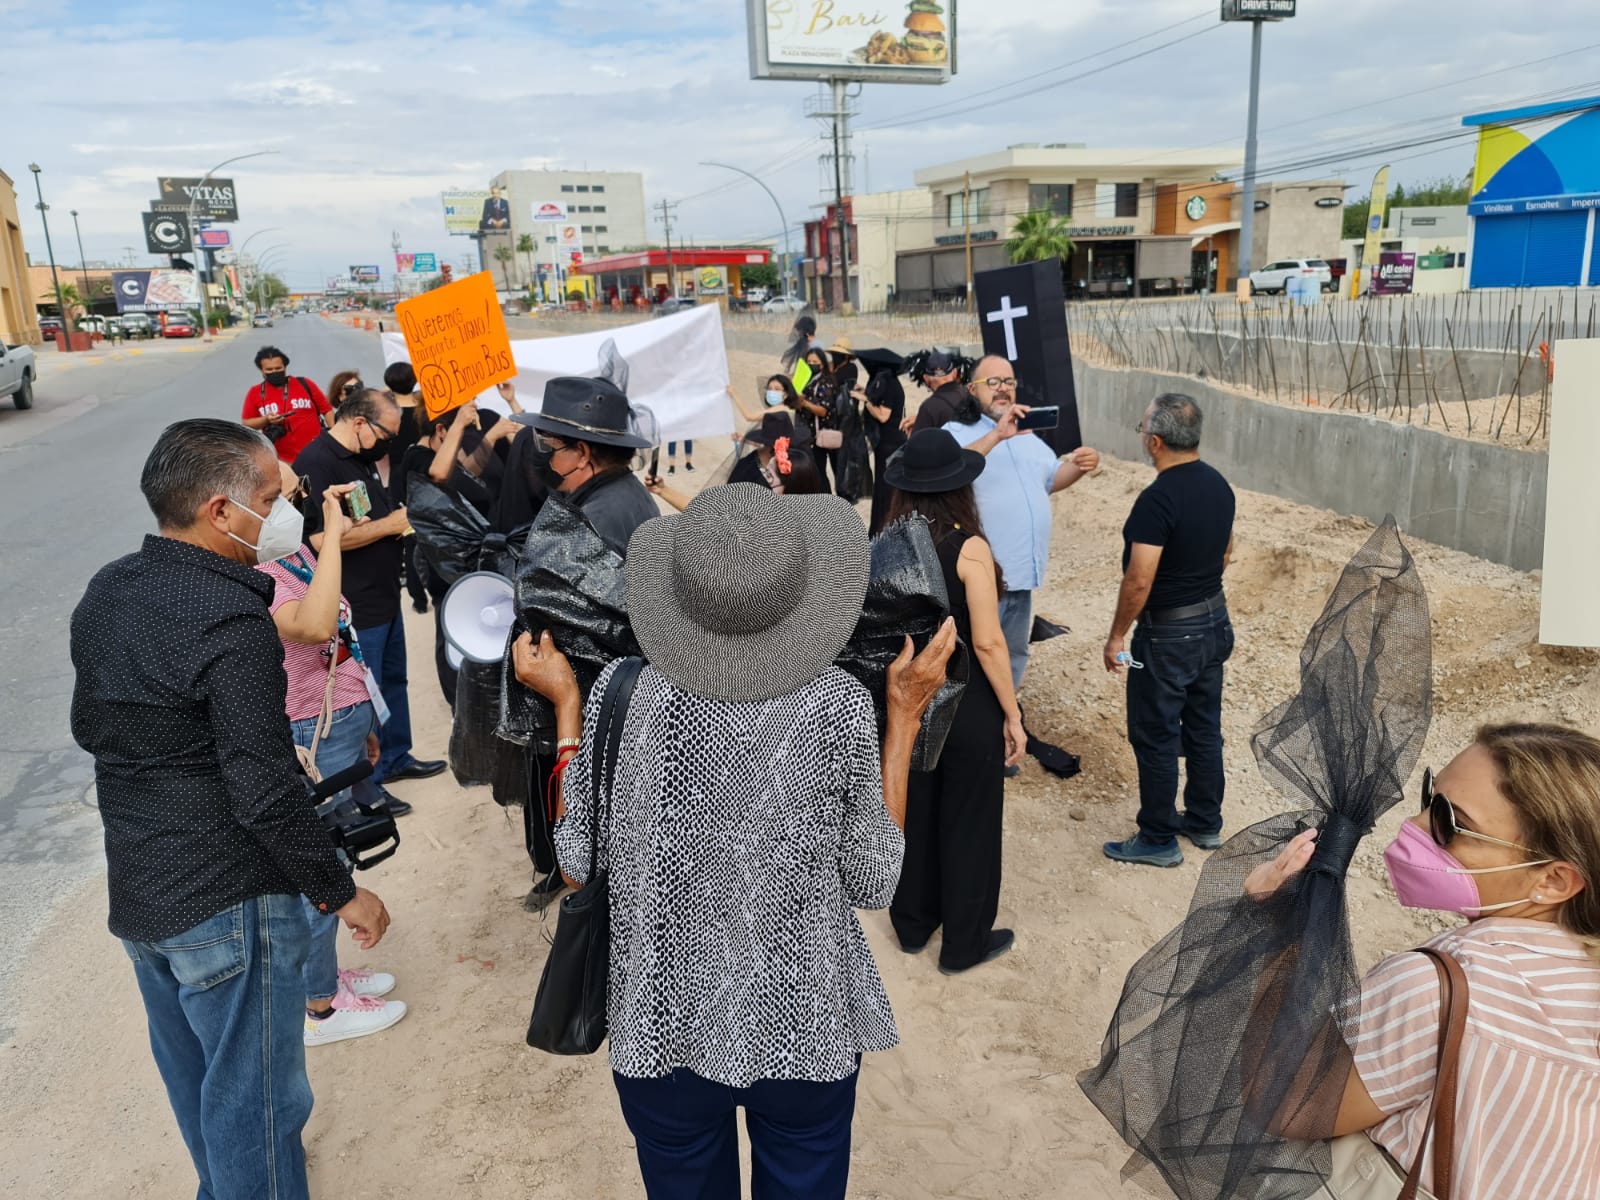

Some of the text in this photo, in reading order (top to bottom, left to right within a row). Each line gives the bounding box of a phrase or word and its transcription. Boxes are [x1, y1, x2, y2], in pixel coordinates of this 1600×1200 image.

[1241, 0, 1294, 11] DRIVE THRU
[804, 0, 888, 36] Bari
[182, 186, 233, 200] VITAS
[423, 344, 510, 400] NO Bravo Bus
[290, 397, 311, 409] SOX
